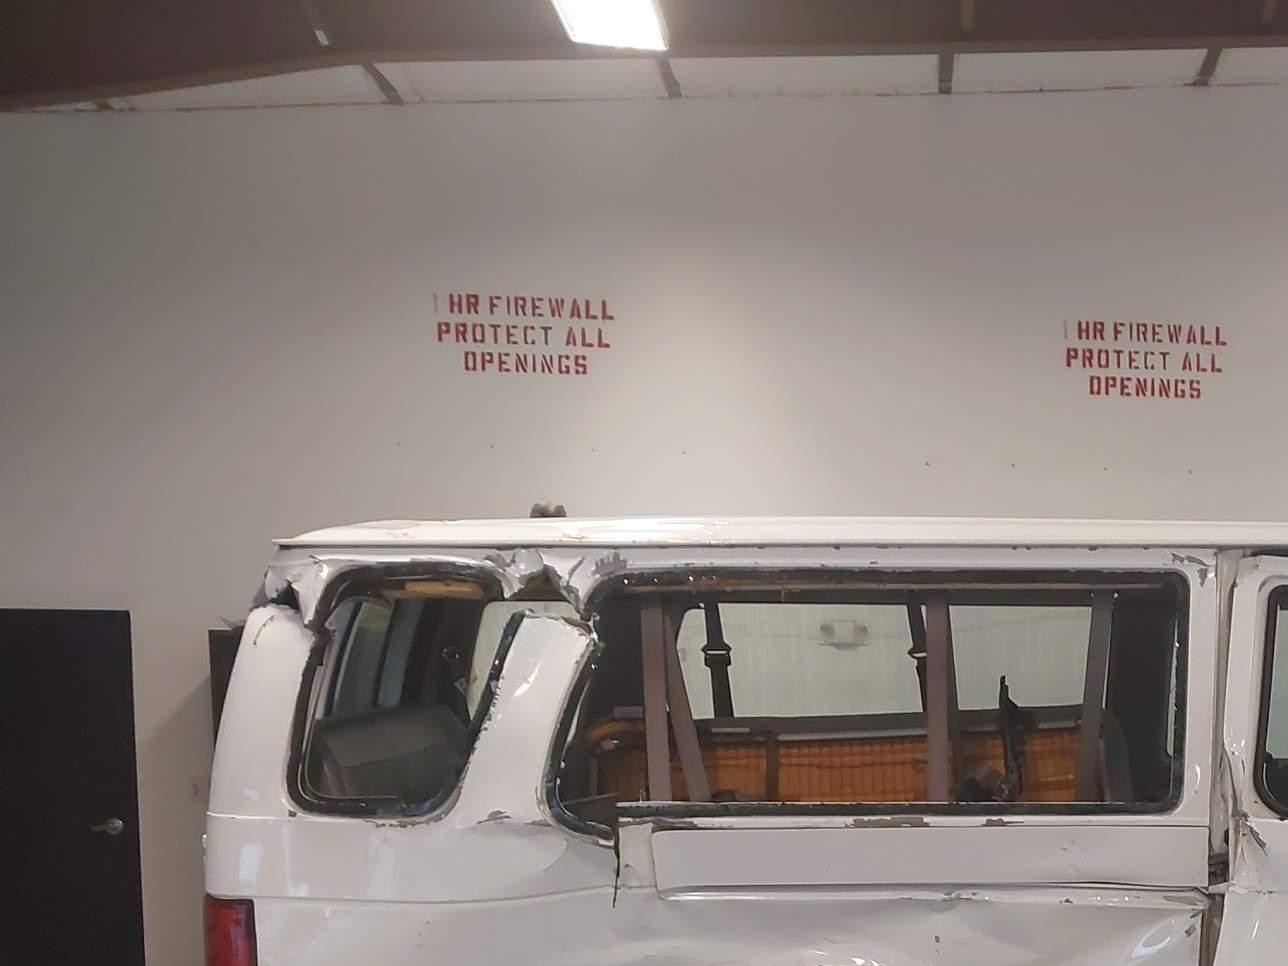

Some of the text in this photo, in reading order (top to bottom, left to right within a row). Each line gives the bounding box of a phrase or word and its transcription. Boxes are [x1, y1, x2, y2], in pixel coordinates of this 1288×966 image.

[449, 293, 480, 315] HR
[489, 295, 615, 321] FIREWALL
[437, 321, 611, 349] PROTECT ALL
[1077, 320, 1105, 341] HR
[1113, 321, 1227, 347] FIREWALL
[464, 350, 588, 375] OPENINGS
[1066, 347, 1223, 374] PROTECT ALL
[1089, 374, 1201, 399] OPENINGS
